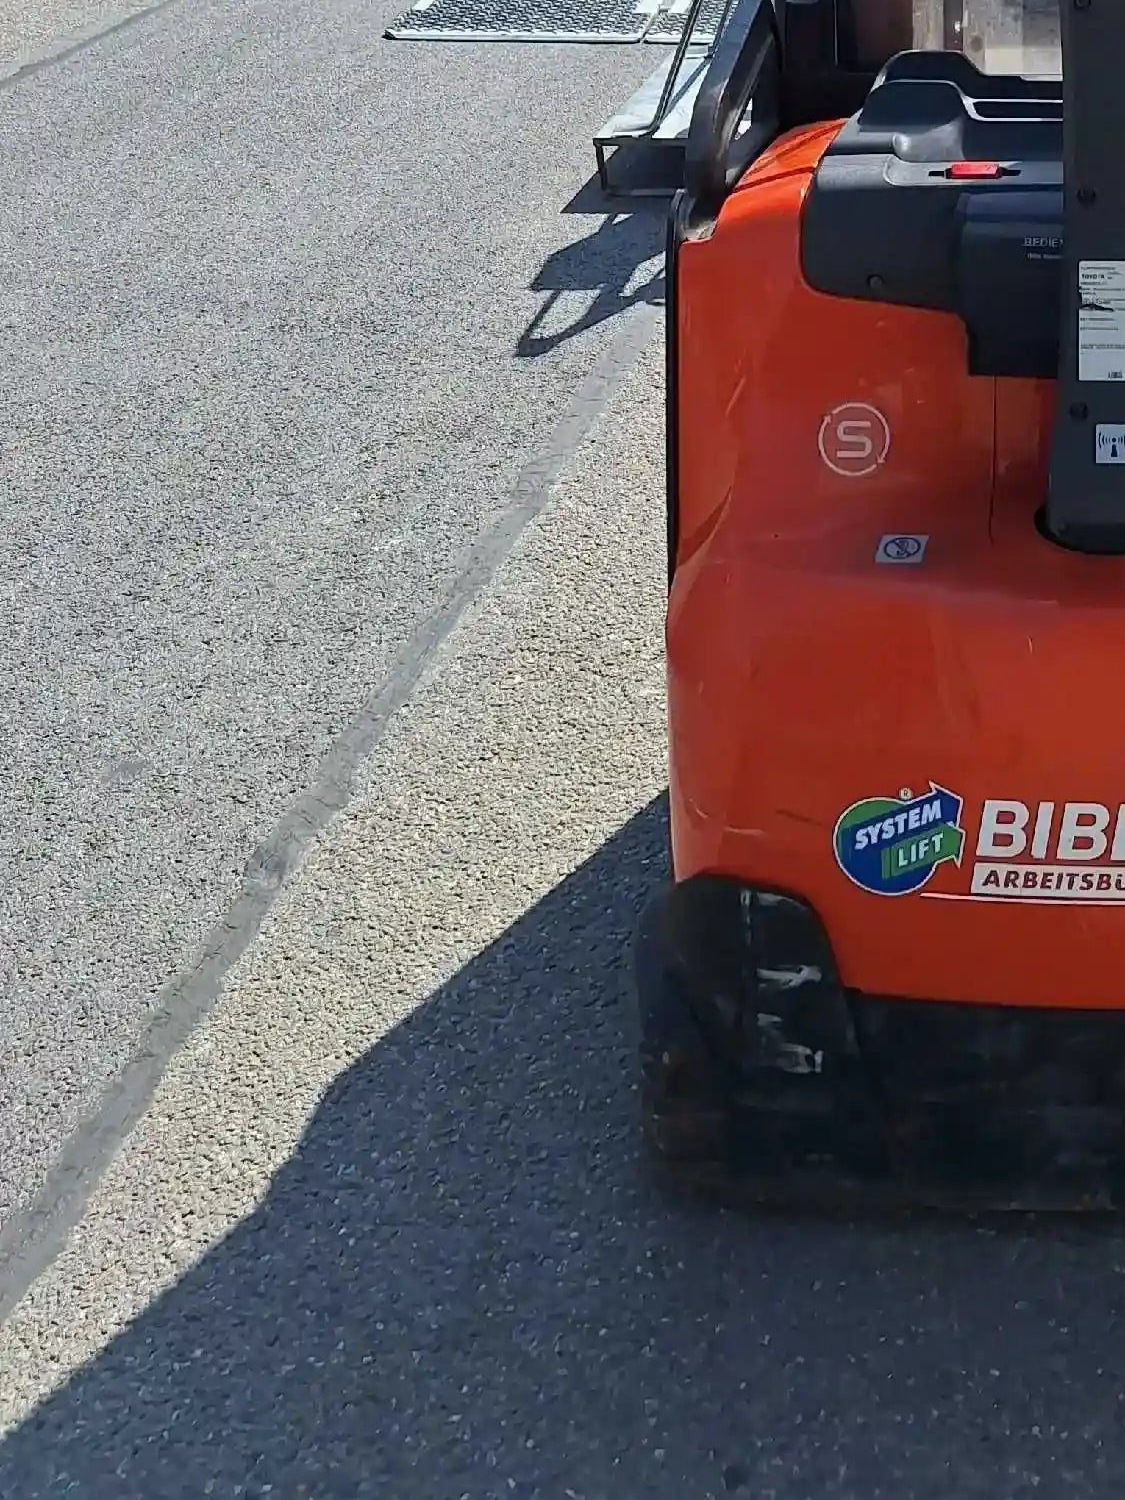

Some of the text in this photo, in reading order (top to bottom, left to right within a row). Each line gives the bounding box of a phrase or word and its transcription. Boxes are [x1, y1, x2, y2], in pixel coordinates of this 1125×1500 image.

[836, 420, 873, 458] S
[854, 799, 942, 850] SYSTEM
[897, 831, 944, 868] LIFT
